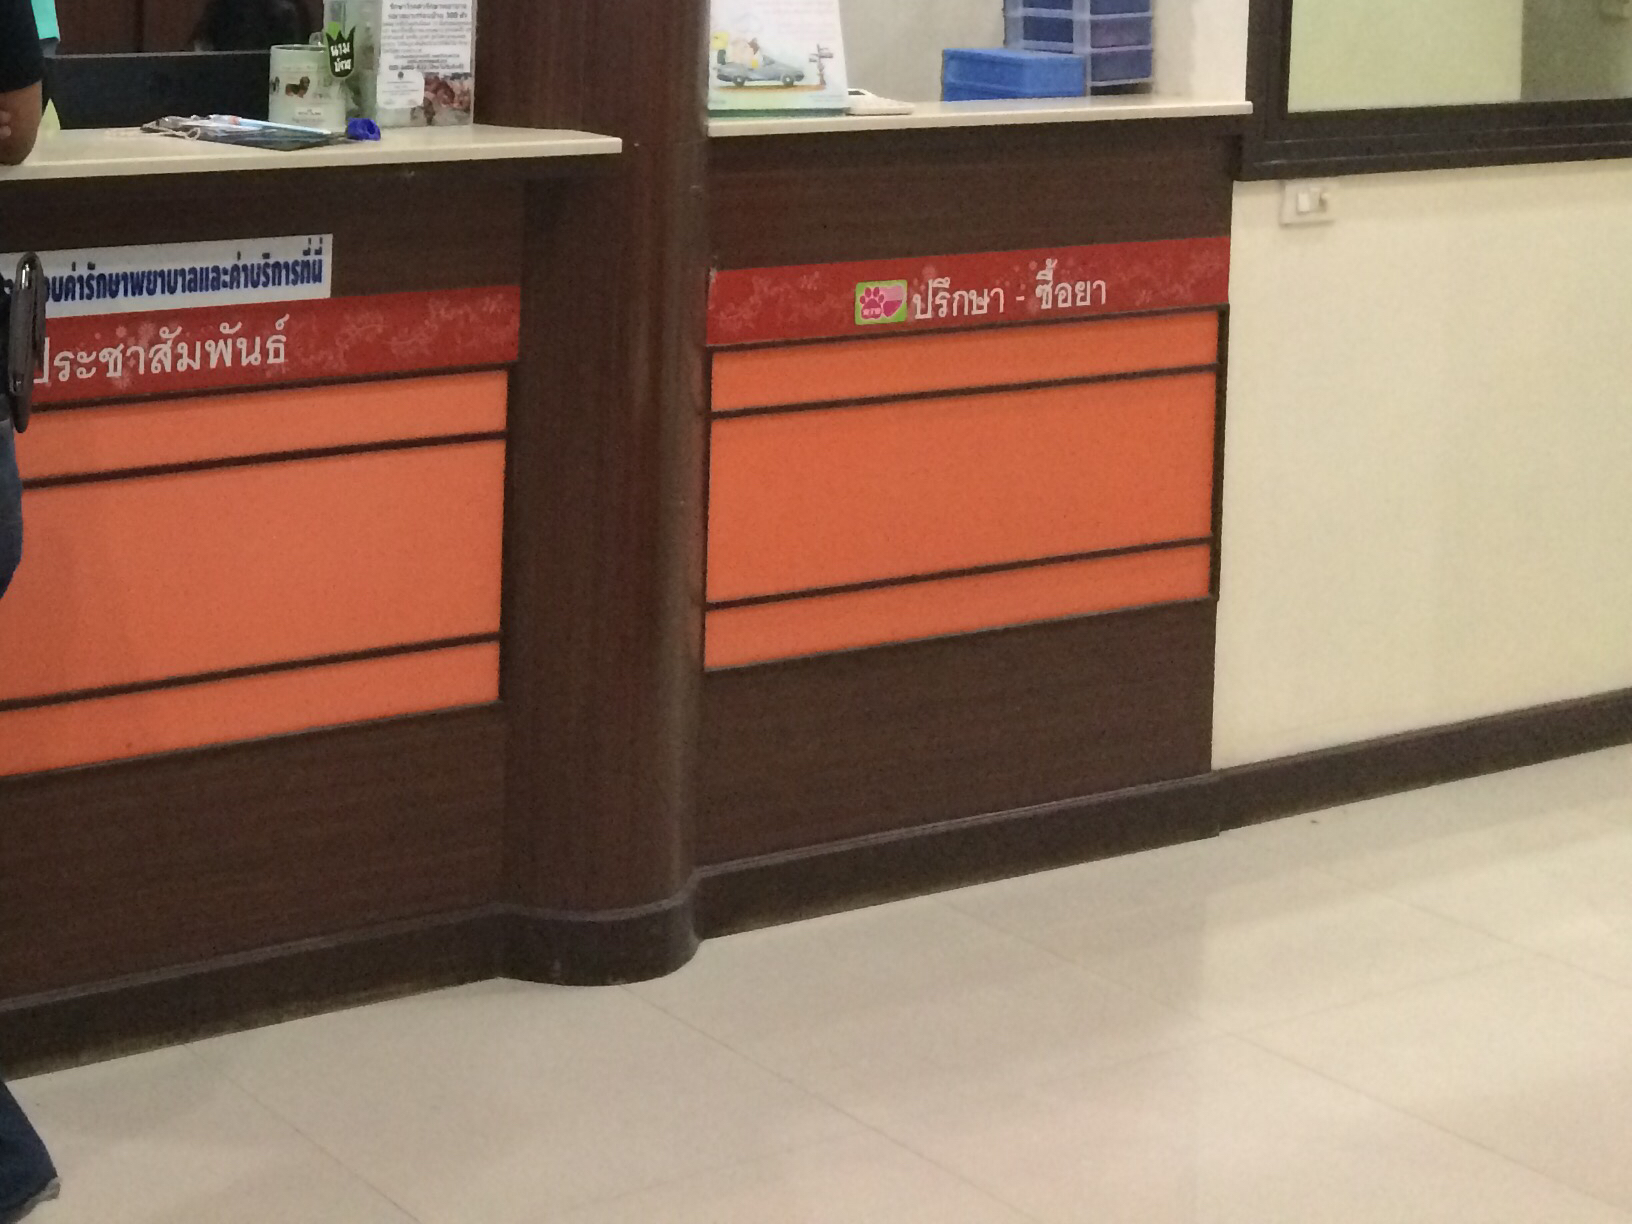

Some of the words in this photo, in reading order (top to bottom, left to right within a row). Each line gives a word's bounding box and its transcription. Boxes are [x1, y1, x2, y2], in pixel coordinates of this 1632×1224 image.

[912, 277, 1005, 321] ปรึกษา
[1034, 257, 1108, 311] ซื้อยา
